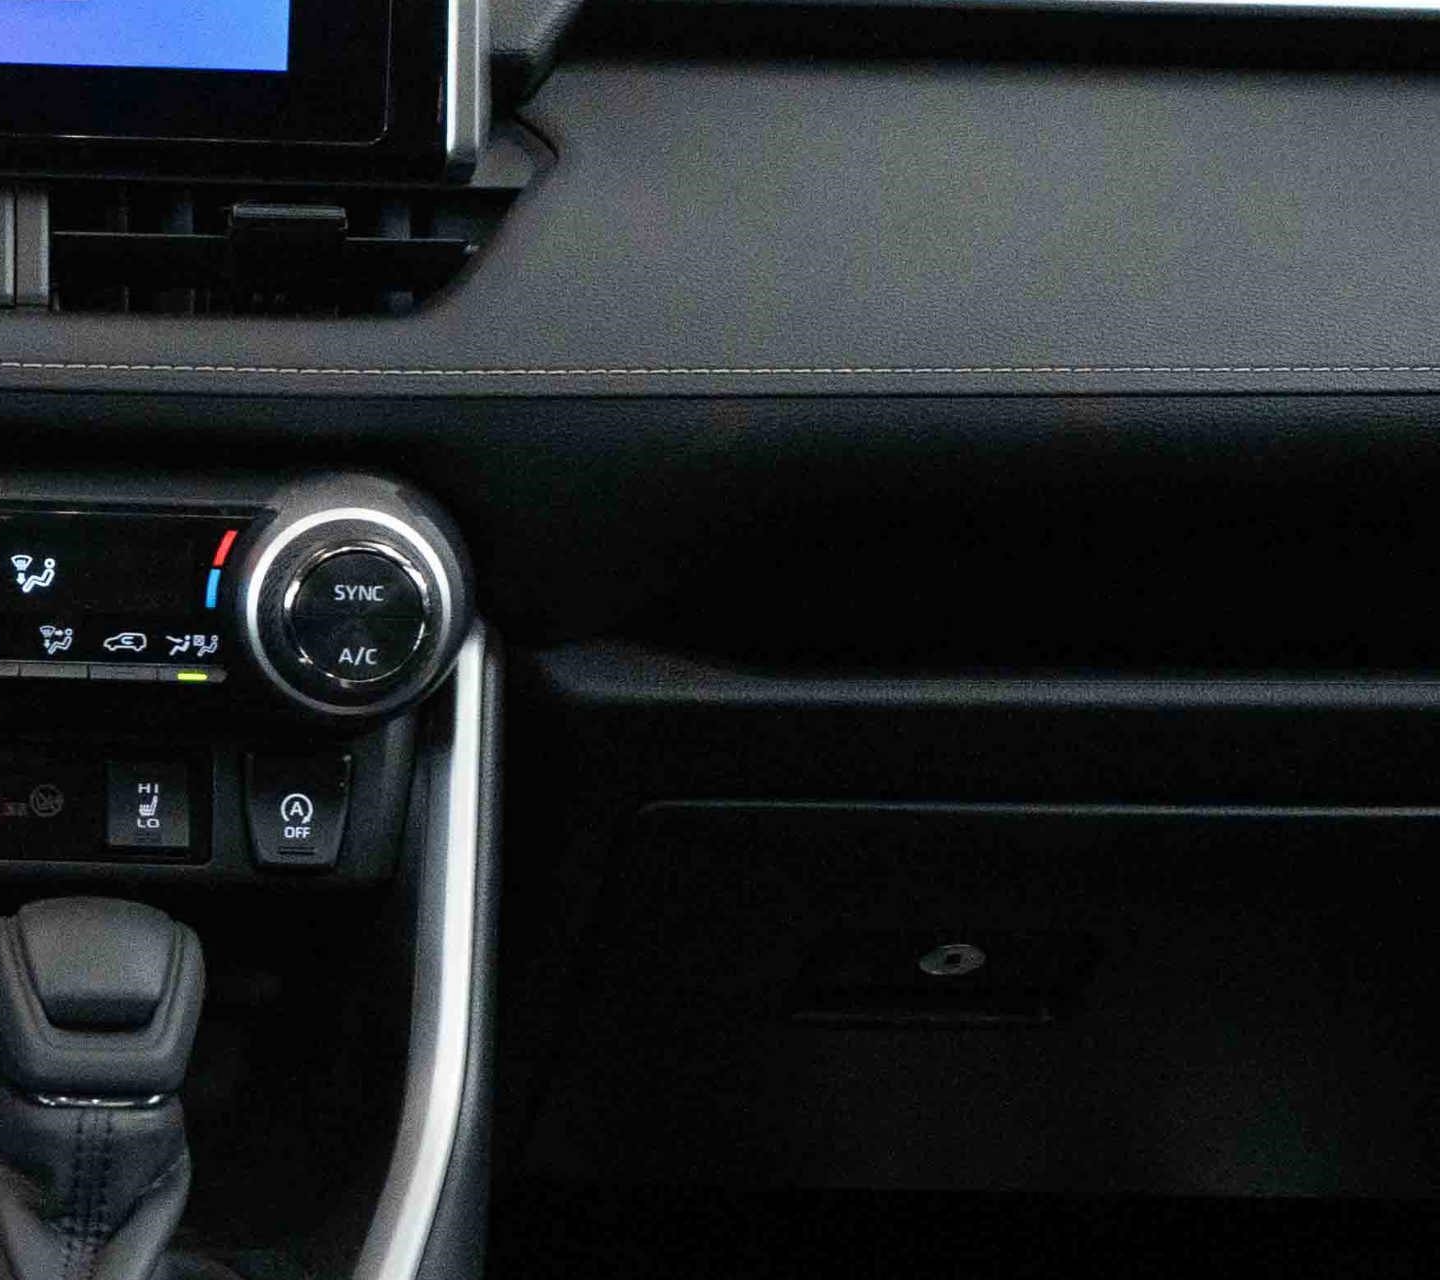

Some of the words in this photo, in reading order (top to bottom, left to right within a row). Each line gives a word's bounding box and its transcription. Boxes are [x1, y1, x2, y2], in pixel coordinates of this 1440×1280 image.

[333, 584, 385, 602] SYNC
[338, 646, 379, 666] A/C
[137, 783, 159, 795] HI
[136, 818, 160, 829] LO
[283, 826, 311, 839] OFF
